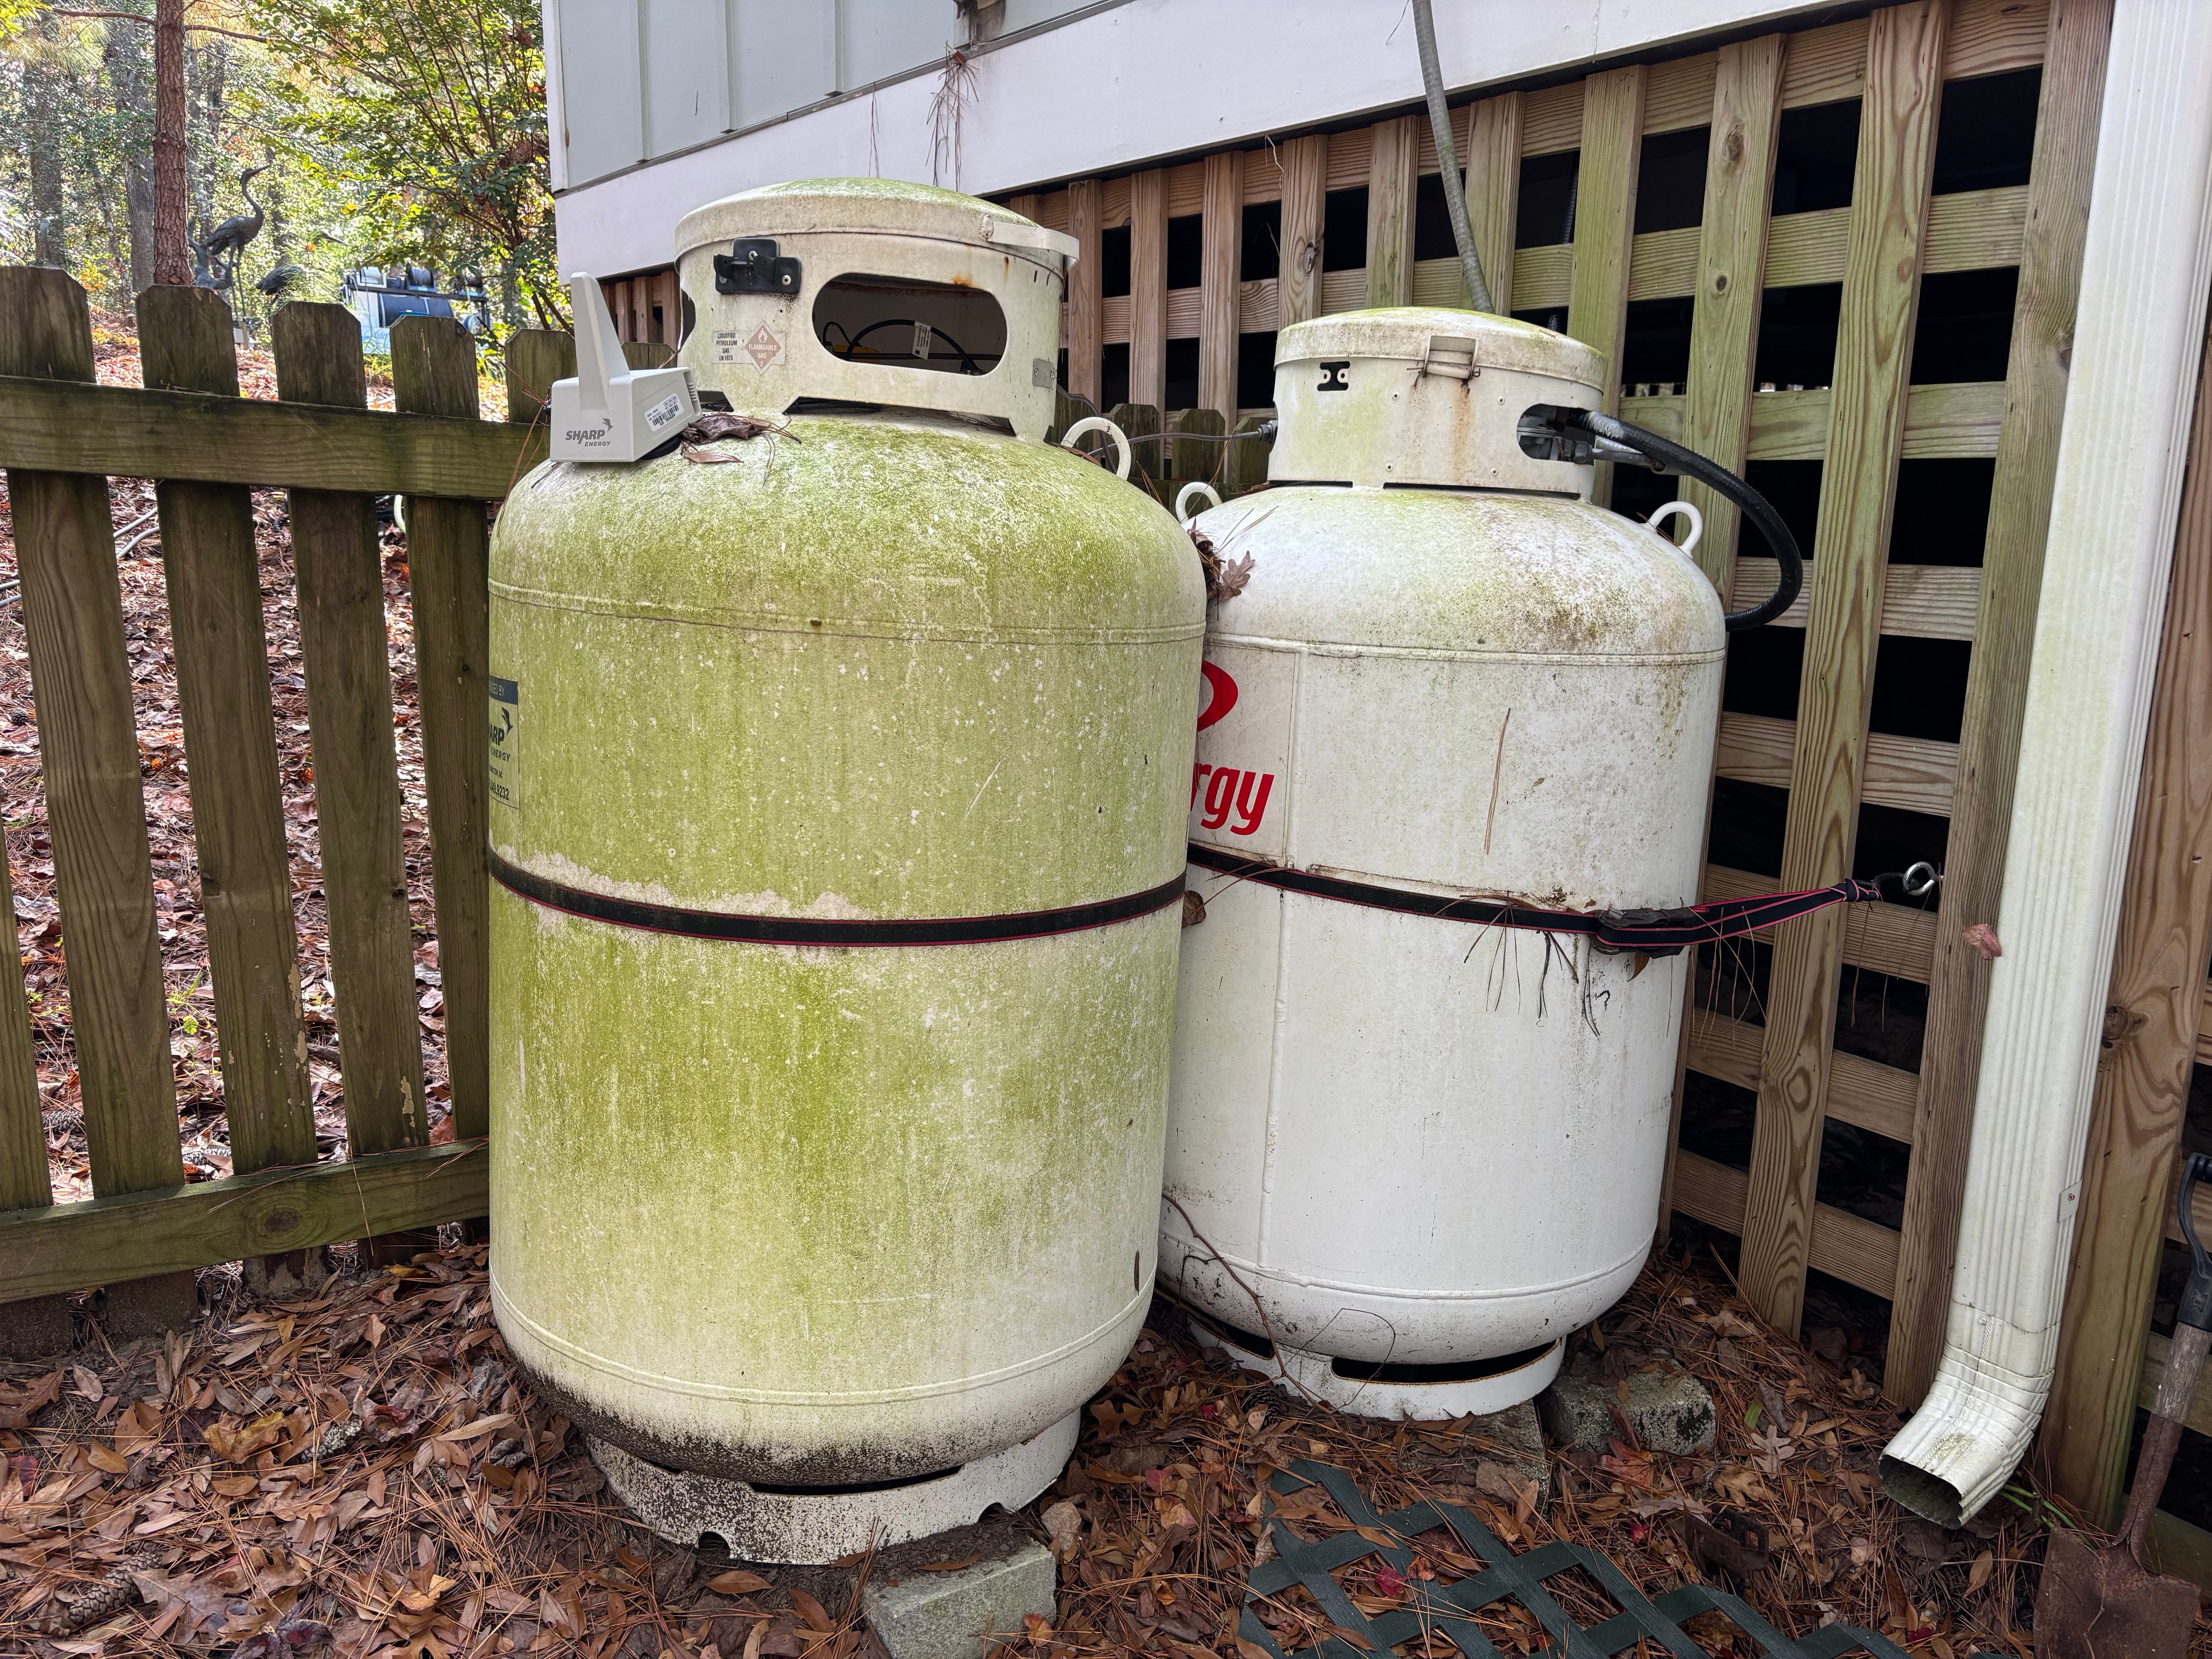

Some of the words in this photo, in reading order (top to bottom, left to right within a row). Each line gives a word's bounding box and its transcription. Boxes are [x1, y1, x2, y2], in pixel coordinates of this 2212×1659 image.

[565, 429, 606, 444] SHARP
[499, 685, 505, 696] BY
[489, 723, 505, 747] ARP
[491, 746, 511, 763] ENERGY
[1190, 763, 1274, 836] rgy
